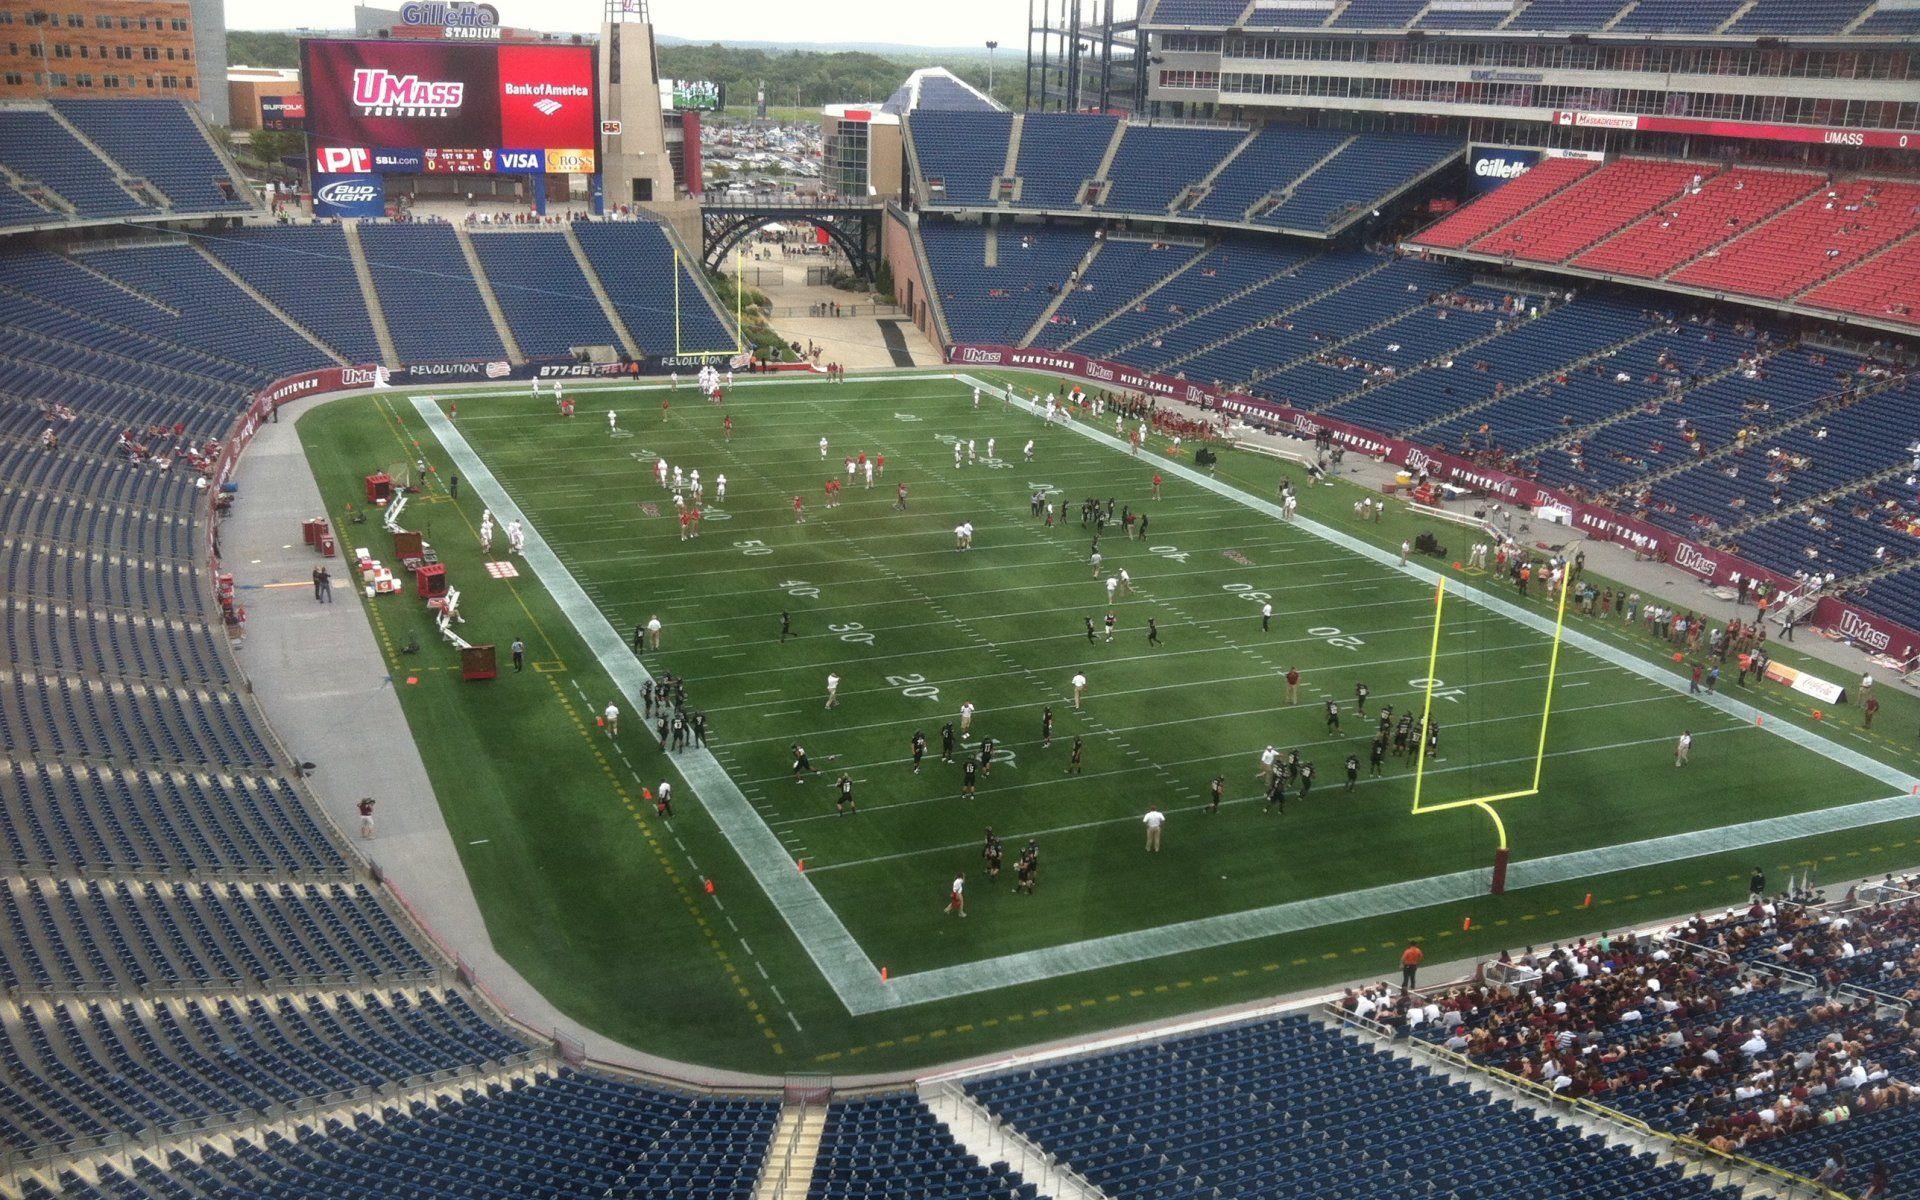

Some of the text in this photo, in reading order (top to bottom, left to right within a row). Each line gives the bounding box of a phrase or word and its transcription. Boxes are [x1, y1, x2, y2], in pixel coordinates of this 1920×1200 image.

[402, 2, 494, 26] Gillette
[445, 27, 500, 38] STADIUM
[505, 83, 588, 96] Bank of America
[365, 107, 447, 117] FOOTBALL
[604, 123, 618, 133] 25
[1824, 131, 1864, 145] UMASS
[1899, 135, 1908, 147] 0
[375, 156, 418, 165] SBLI.com
[500, 153, 539, 168] VISA
[547, 152, 593, 166] CROSS
[326, 193, 377, 201] LIGHT
[335, 185, 374, 194] BUD
[410, 364, 479, 376] REVOLUTION
[1012, 355, 1075, 370] MINUTEMEN
[342, 368, 376, 384] UMAS
[1333, 430, 1392, 456] MINUTEMN
[1451, 467, 1518, 497] MINUTEMN
[733, 539, 774, 555] 50
[780, 580, 821, 596] 40
[828, 621, 876, 643] 30
[1307, 626, 1366, 648] 20
[885, 673, 940, 698] 20
[1409, 678, 1466, 700] 10
